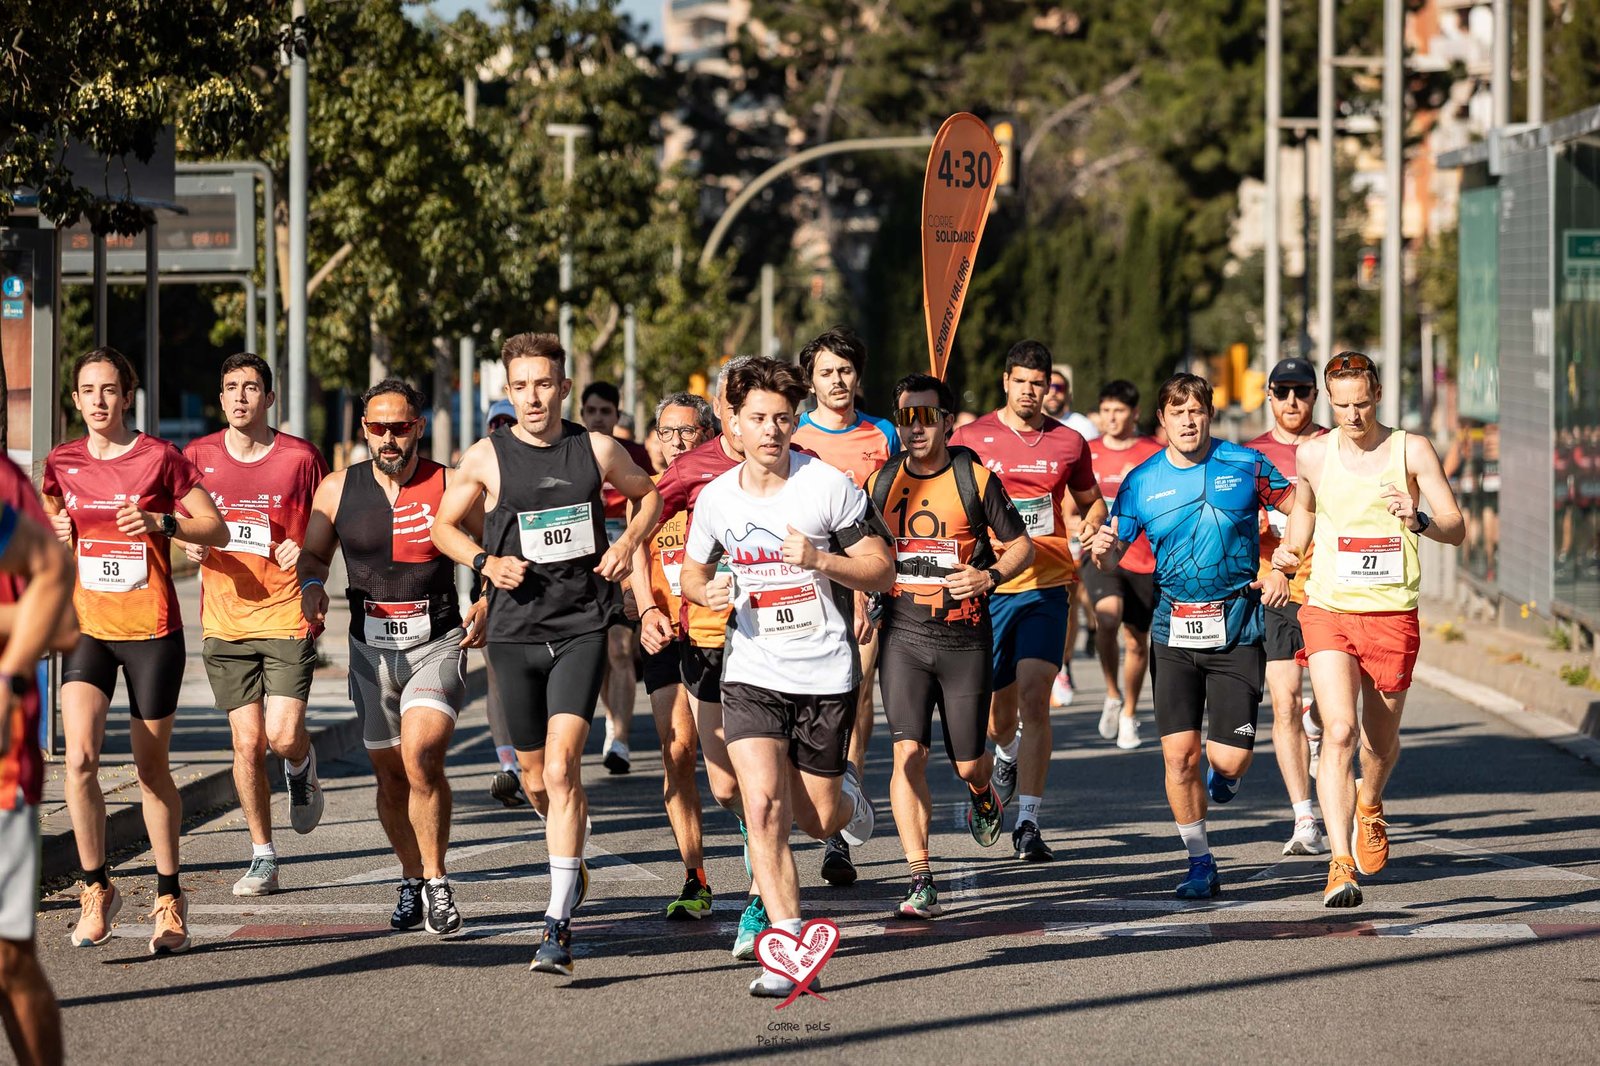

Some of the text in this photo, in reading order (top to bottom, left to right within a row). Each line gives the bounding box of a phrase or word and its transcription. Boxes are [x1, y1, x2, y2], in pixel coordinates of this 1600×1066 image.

[938, 150, 992, 189] 4:30
[928, 214, 954, 229] CORRE
[936, 230, 976, 244] SOLIDARIS
[936, 255, 971, 357] SPORTS I VALORS
[1020, 513, 1038, 526] 98
[238, 525, 252, 539] 73
[543, 527, 572, 546] 802
[103, 561, 120, 577] 53
[1362, 555, 1378, 570] 27
[776, 608, 795, 624] 40
[383, 621, 408, 635] 166
[1185, 620, 1203, 634] 113
